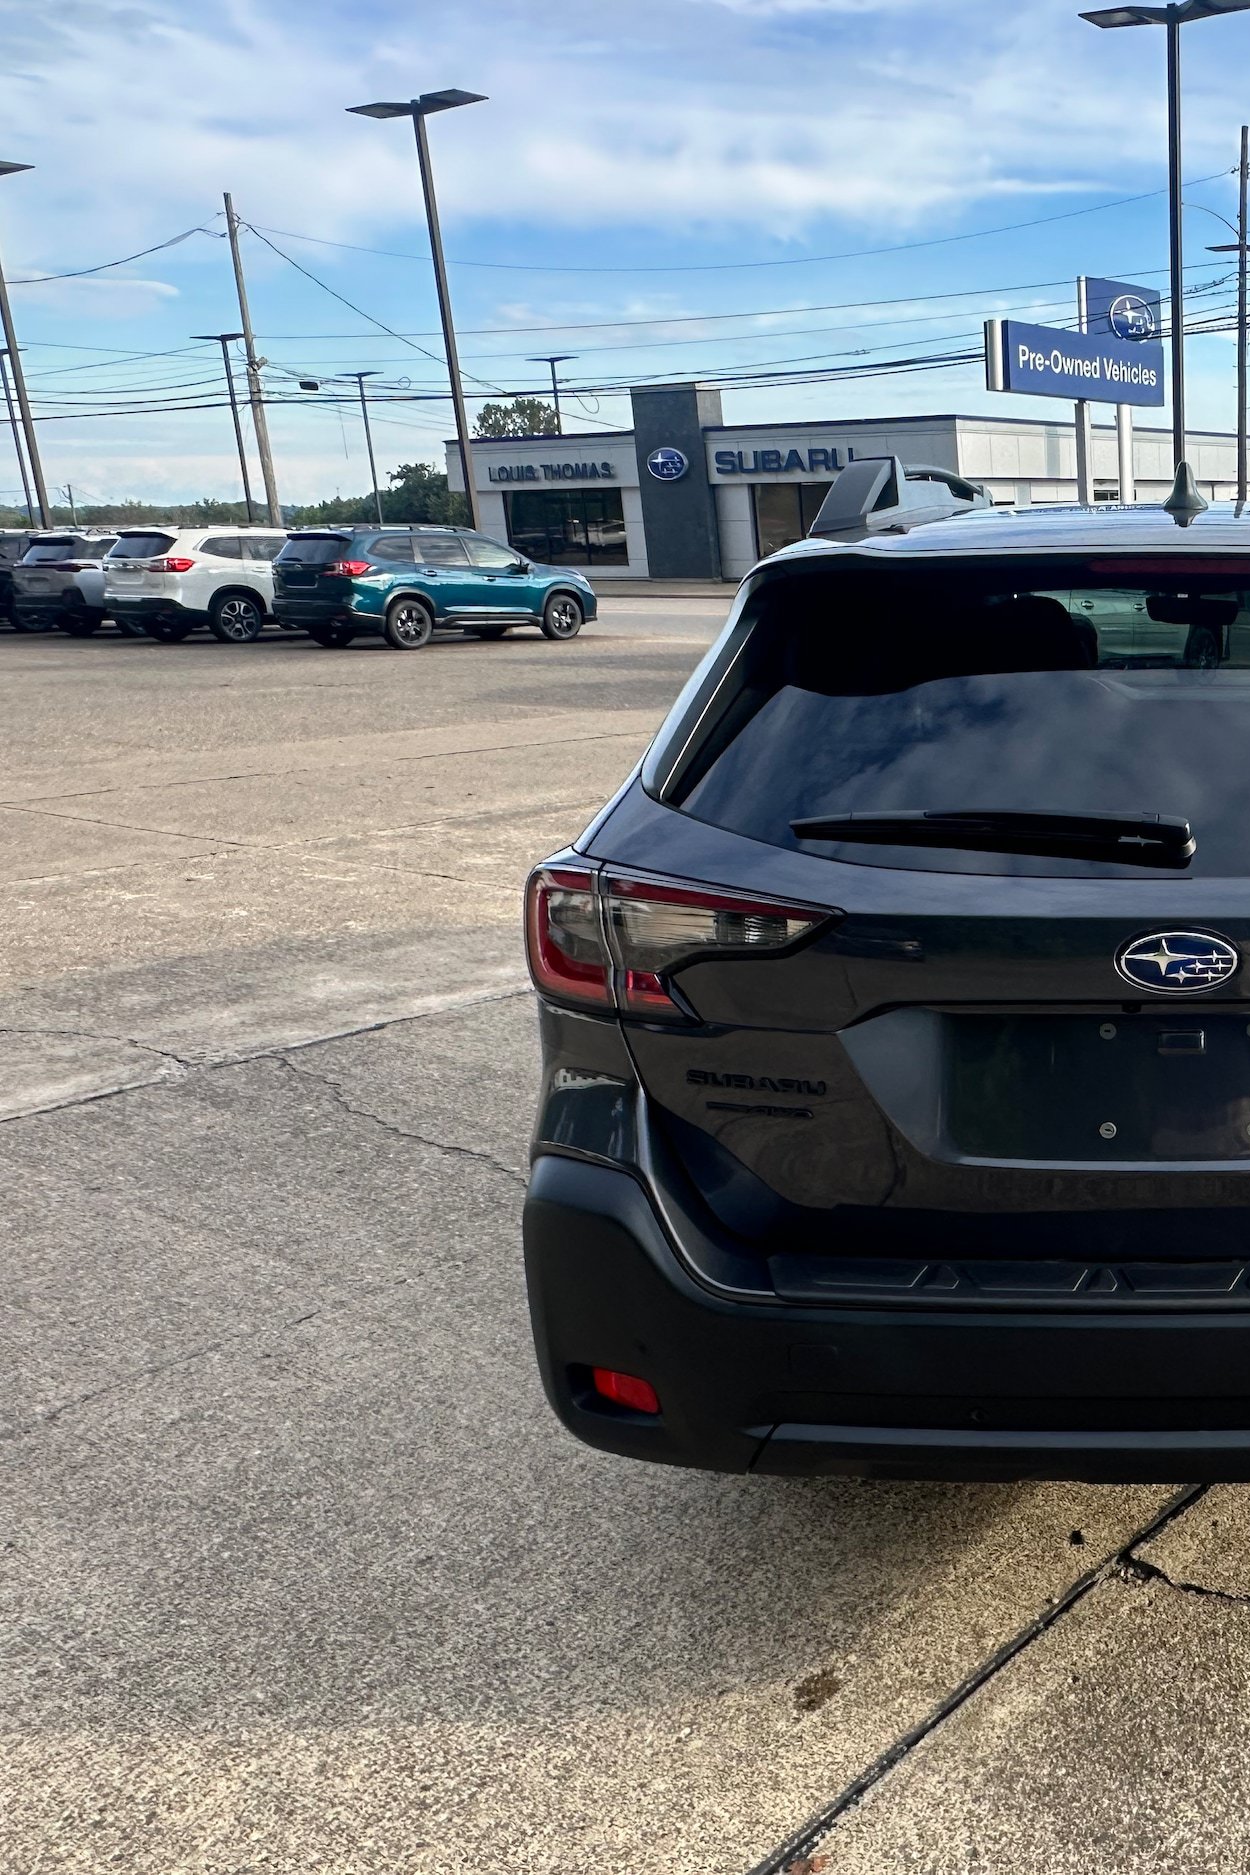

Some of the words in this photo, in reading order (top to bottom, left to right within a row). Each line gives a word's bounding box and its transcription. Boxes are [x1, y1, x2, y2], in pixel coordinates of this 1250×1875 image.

[1018, 344, 1100, 379] Pre-Owned
[1103, 357, 1157, 387] Vehicles
[488, 464, 537, 482] LOUIS
[540, 461, 612, 481] THOMAS
[686, 1069, 827, 1096] SUBARU
